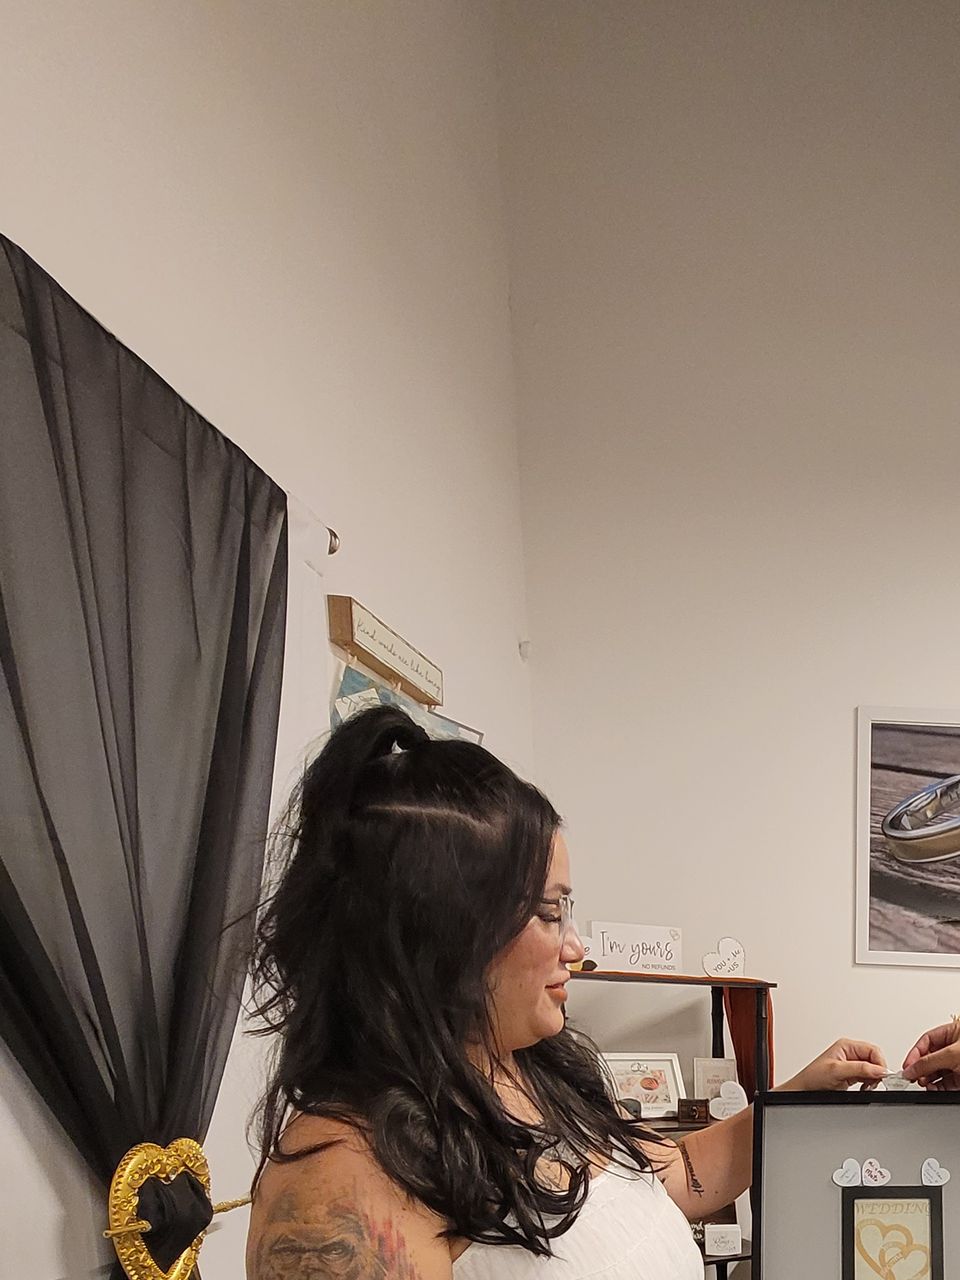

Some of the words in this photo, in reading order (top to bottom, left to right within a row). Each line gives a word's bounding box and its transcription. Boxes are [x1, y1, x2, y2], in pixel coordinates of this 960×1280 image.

[600, 931, 626, 957] I'm
[628, 941, 673, 966] yours
[652, 963, 677, 971] REFUNDS
[713, 960, 727, 972] YOU
